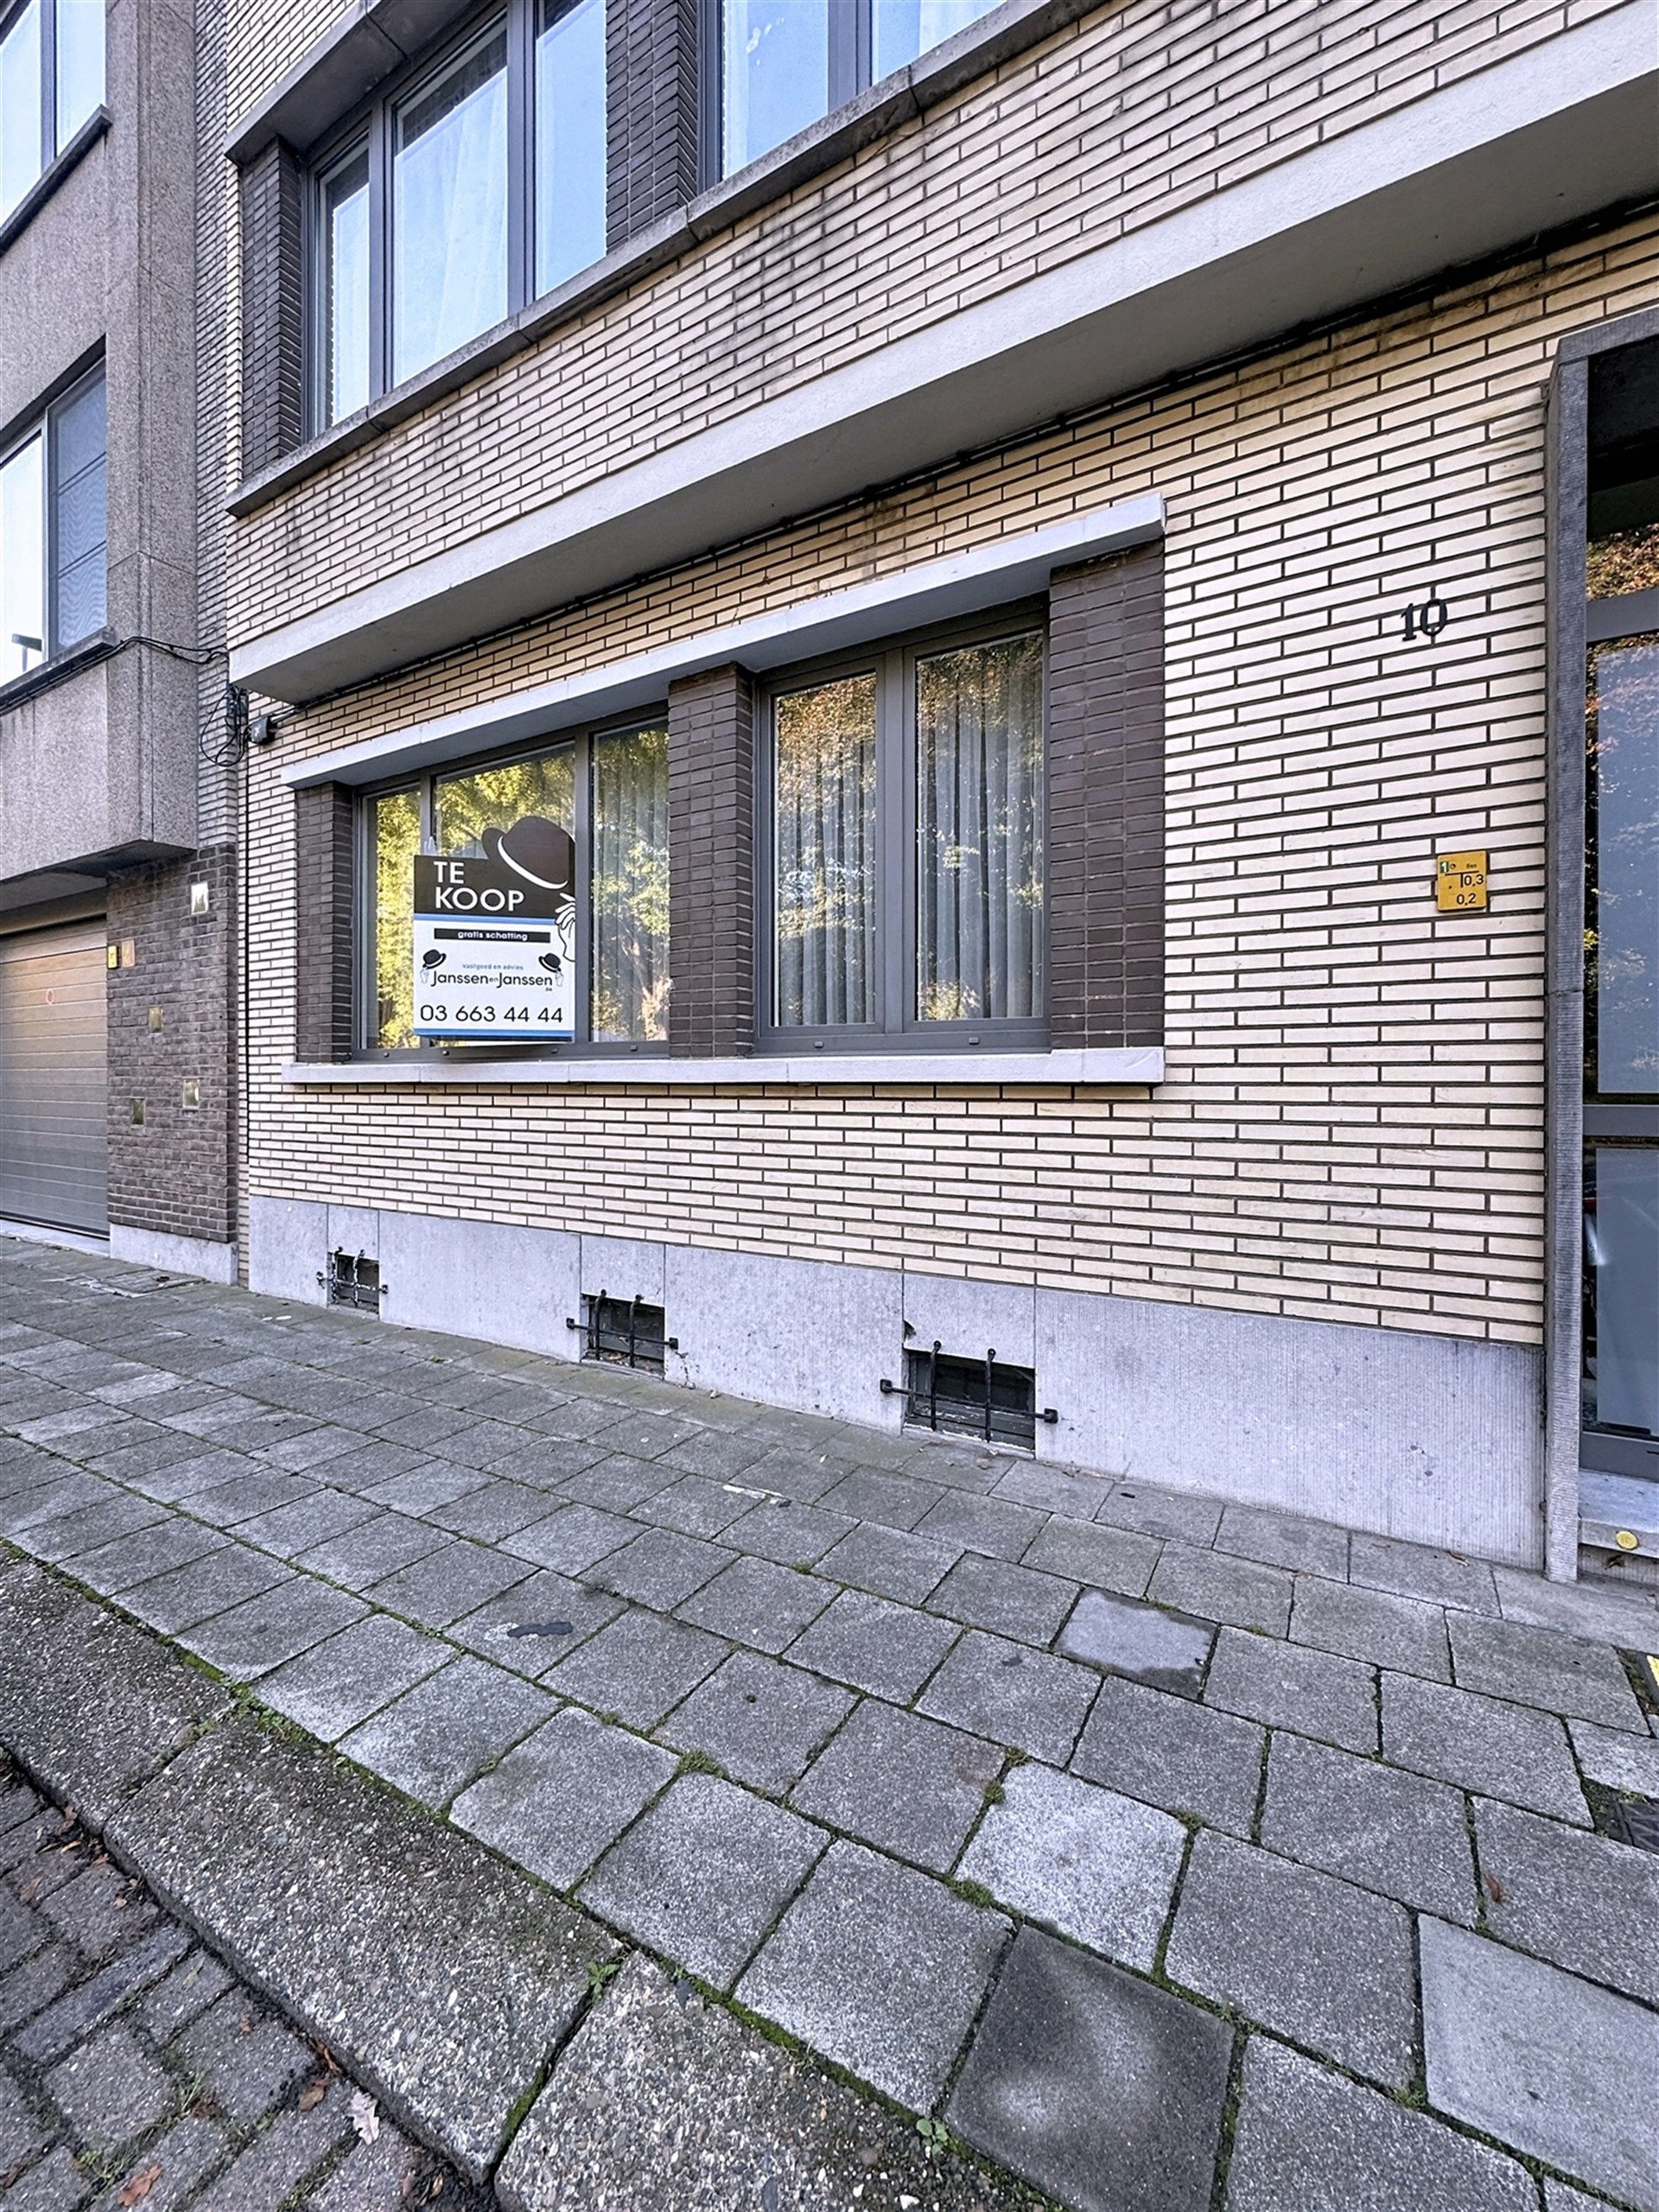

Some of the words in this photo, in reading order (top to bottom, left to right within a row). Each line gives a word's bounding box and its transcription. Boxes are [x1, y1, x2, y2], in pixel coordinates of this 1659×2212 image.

[1401, 598, 1447, 641] 10
[433, 861, 465, 884] TE
[435, 887, 524, 912] KOOP
[1456, 893, 1477, 906] 0,2
[486, 931, 528, 942] schatting
[420, 1004, 448, 1021] 03
[455, 1005, 496, 1022] 663
[503, 1007, 530, 1022] 44
[537, 1007, 563, 1023] 44
